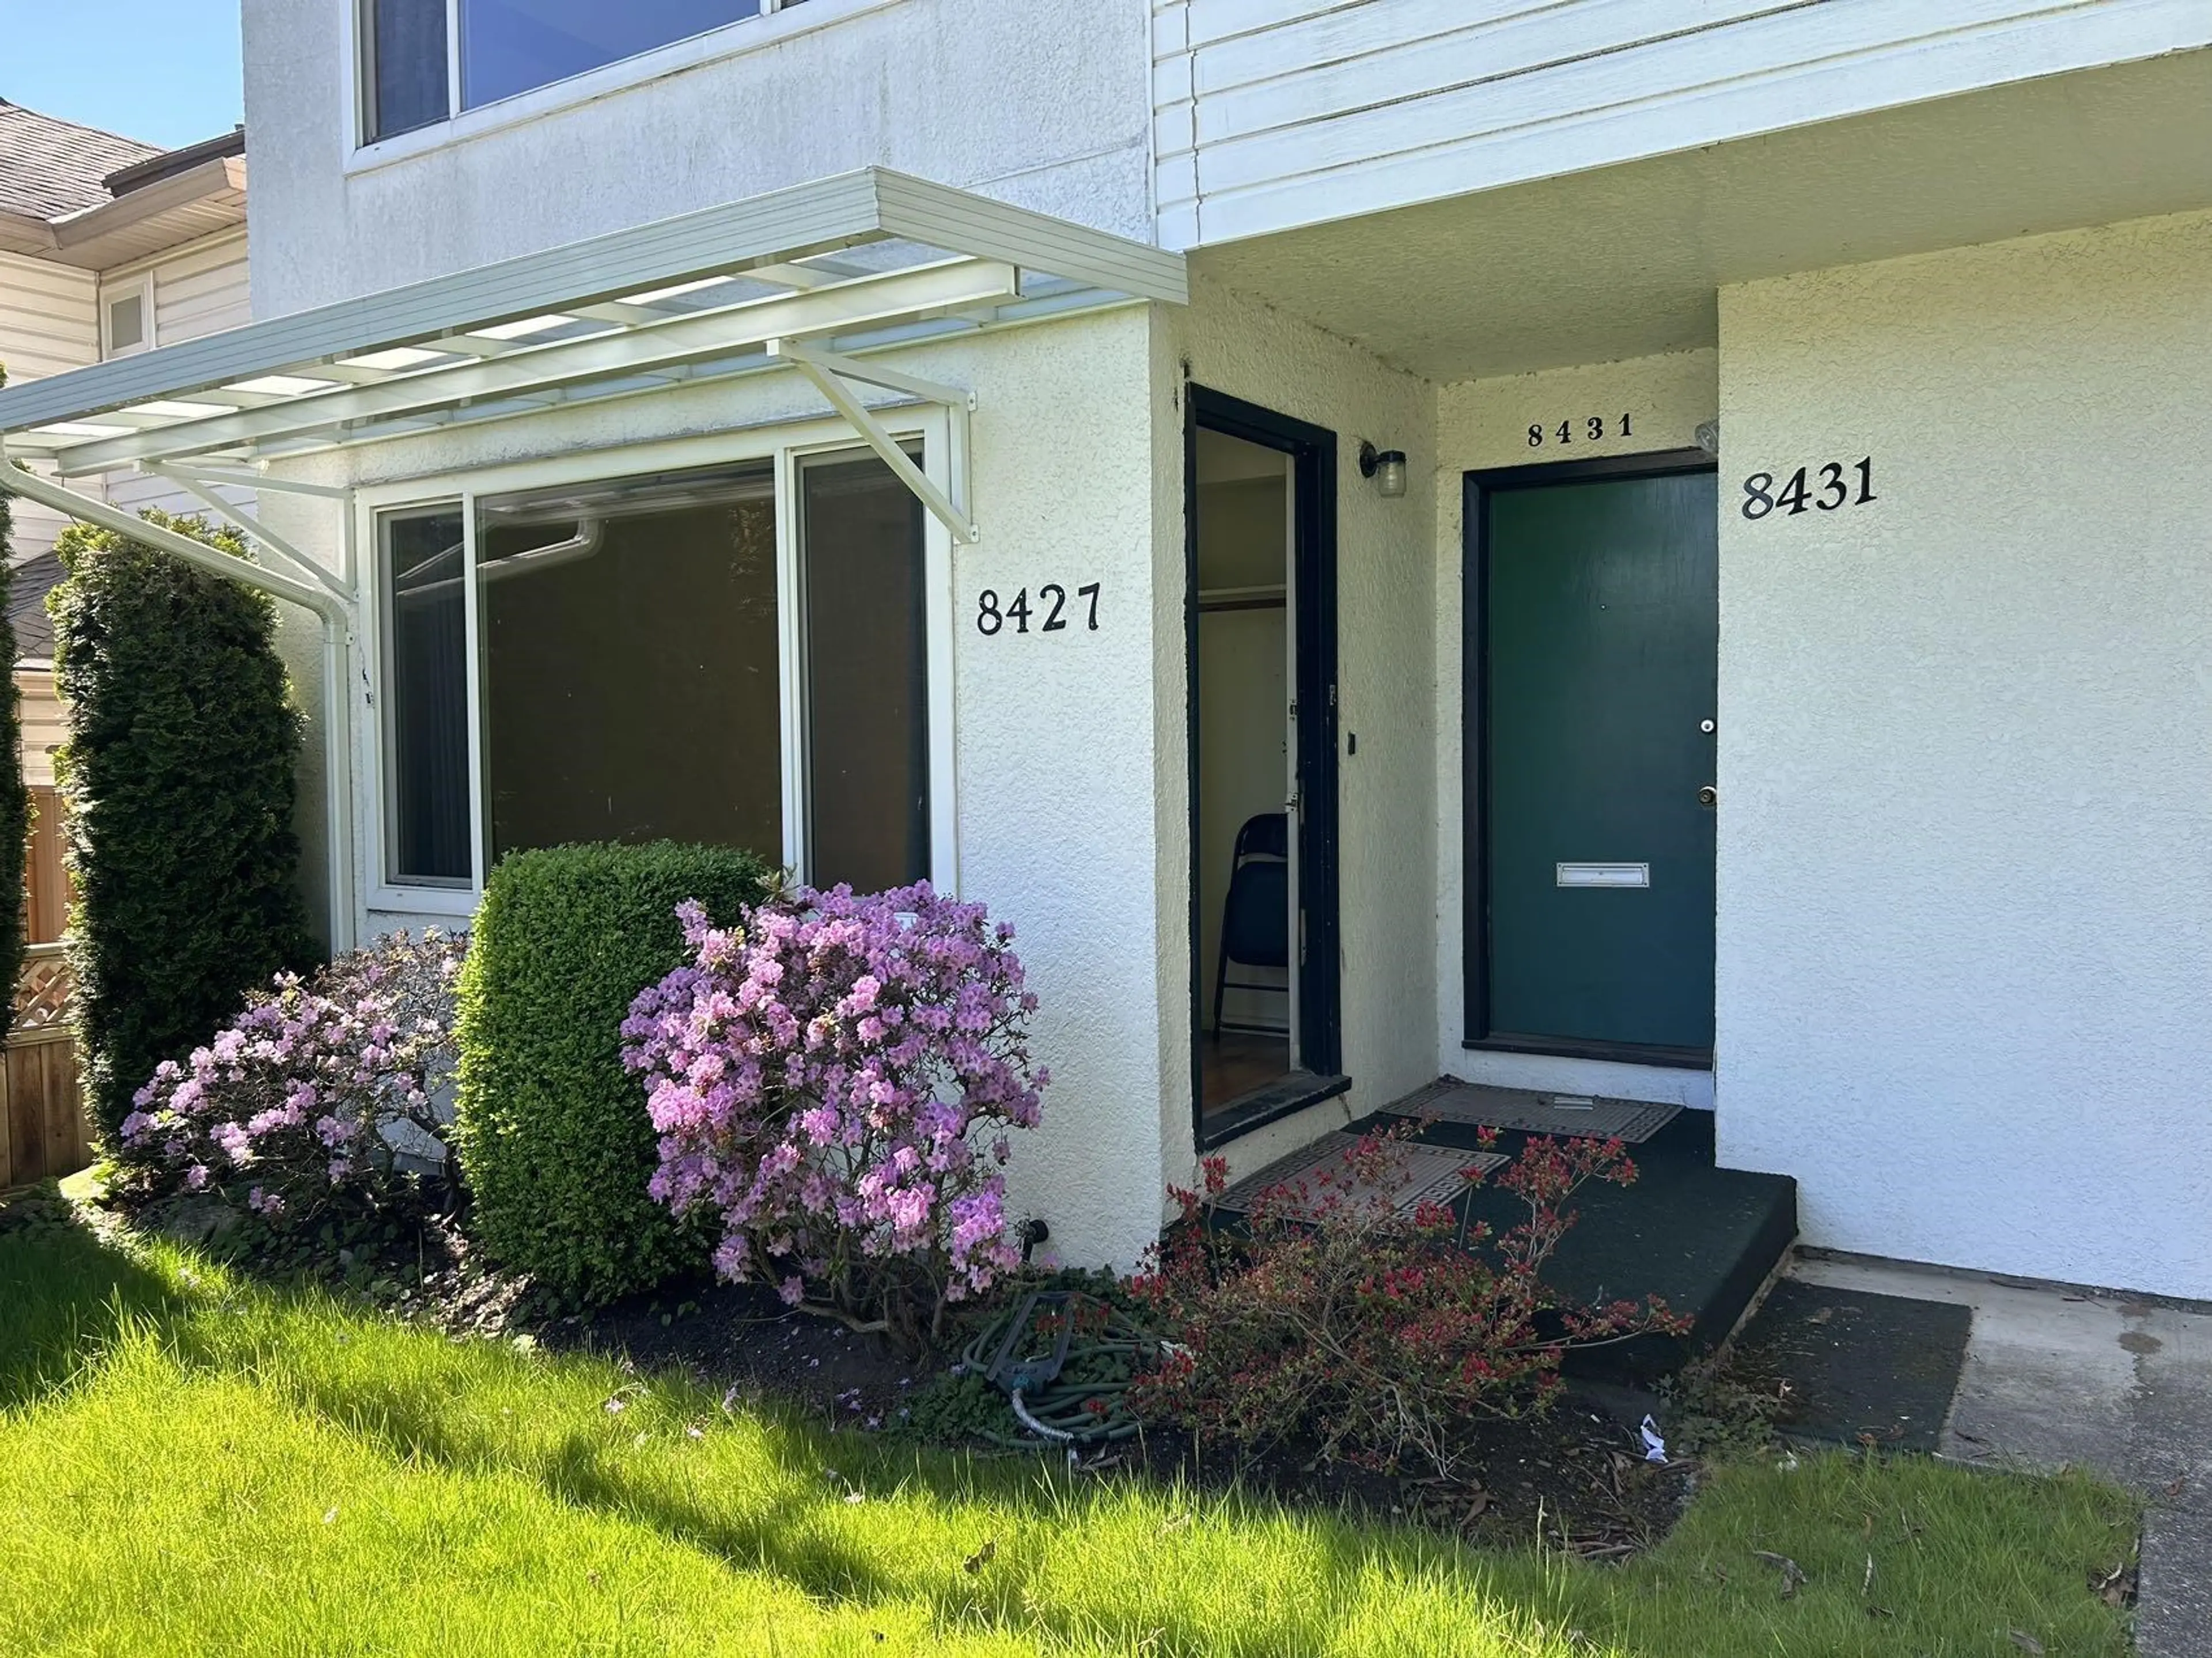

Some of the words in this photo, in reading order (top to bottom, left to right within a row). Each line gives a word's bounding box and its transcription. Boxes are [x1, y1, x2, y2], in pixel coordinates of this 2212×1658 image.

[1528, 413, 1633, 447] 8431
[1741, 456, 1877, 520] 8431
[977, 582, 1100, 636] 8427
